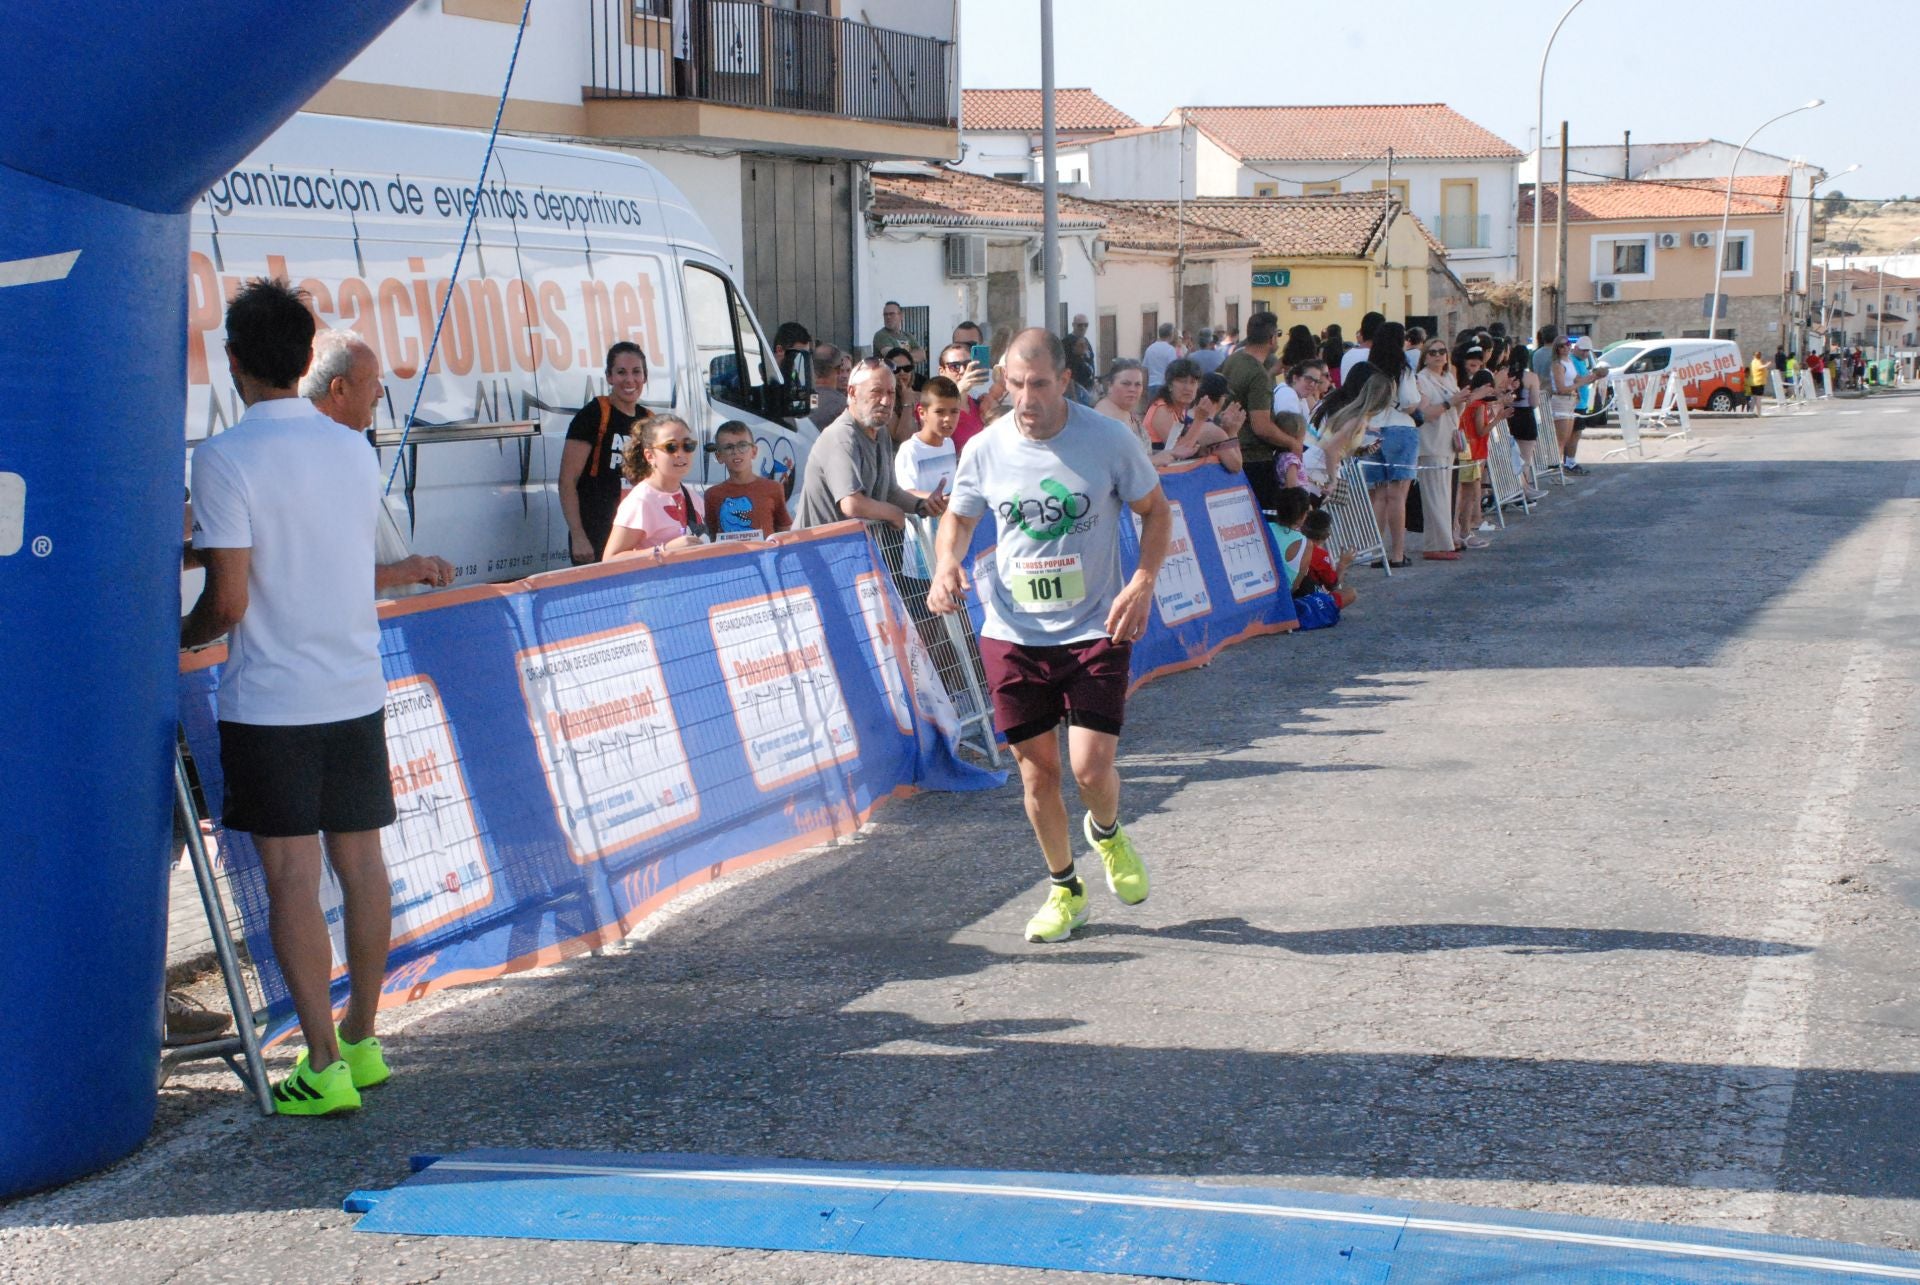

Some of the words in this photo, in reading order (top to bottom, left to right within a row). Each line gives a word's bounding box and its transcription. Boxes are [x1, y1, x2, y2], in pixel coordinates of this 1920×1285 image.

[387, 173, 424, 215] de
[434, 180, 528, 219] eventos
[534, 185, 642, 230] deportivos
[1044, 557, 1075, 568] POPULAR
[1028, 576, 1062, 600] 101
[574, 656, 584, 671] DE
[583, 648, 612, 668] EVENTOS
[547, 685, 659, 745] Pulsaciones.net
